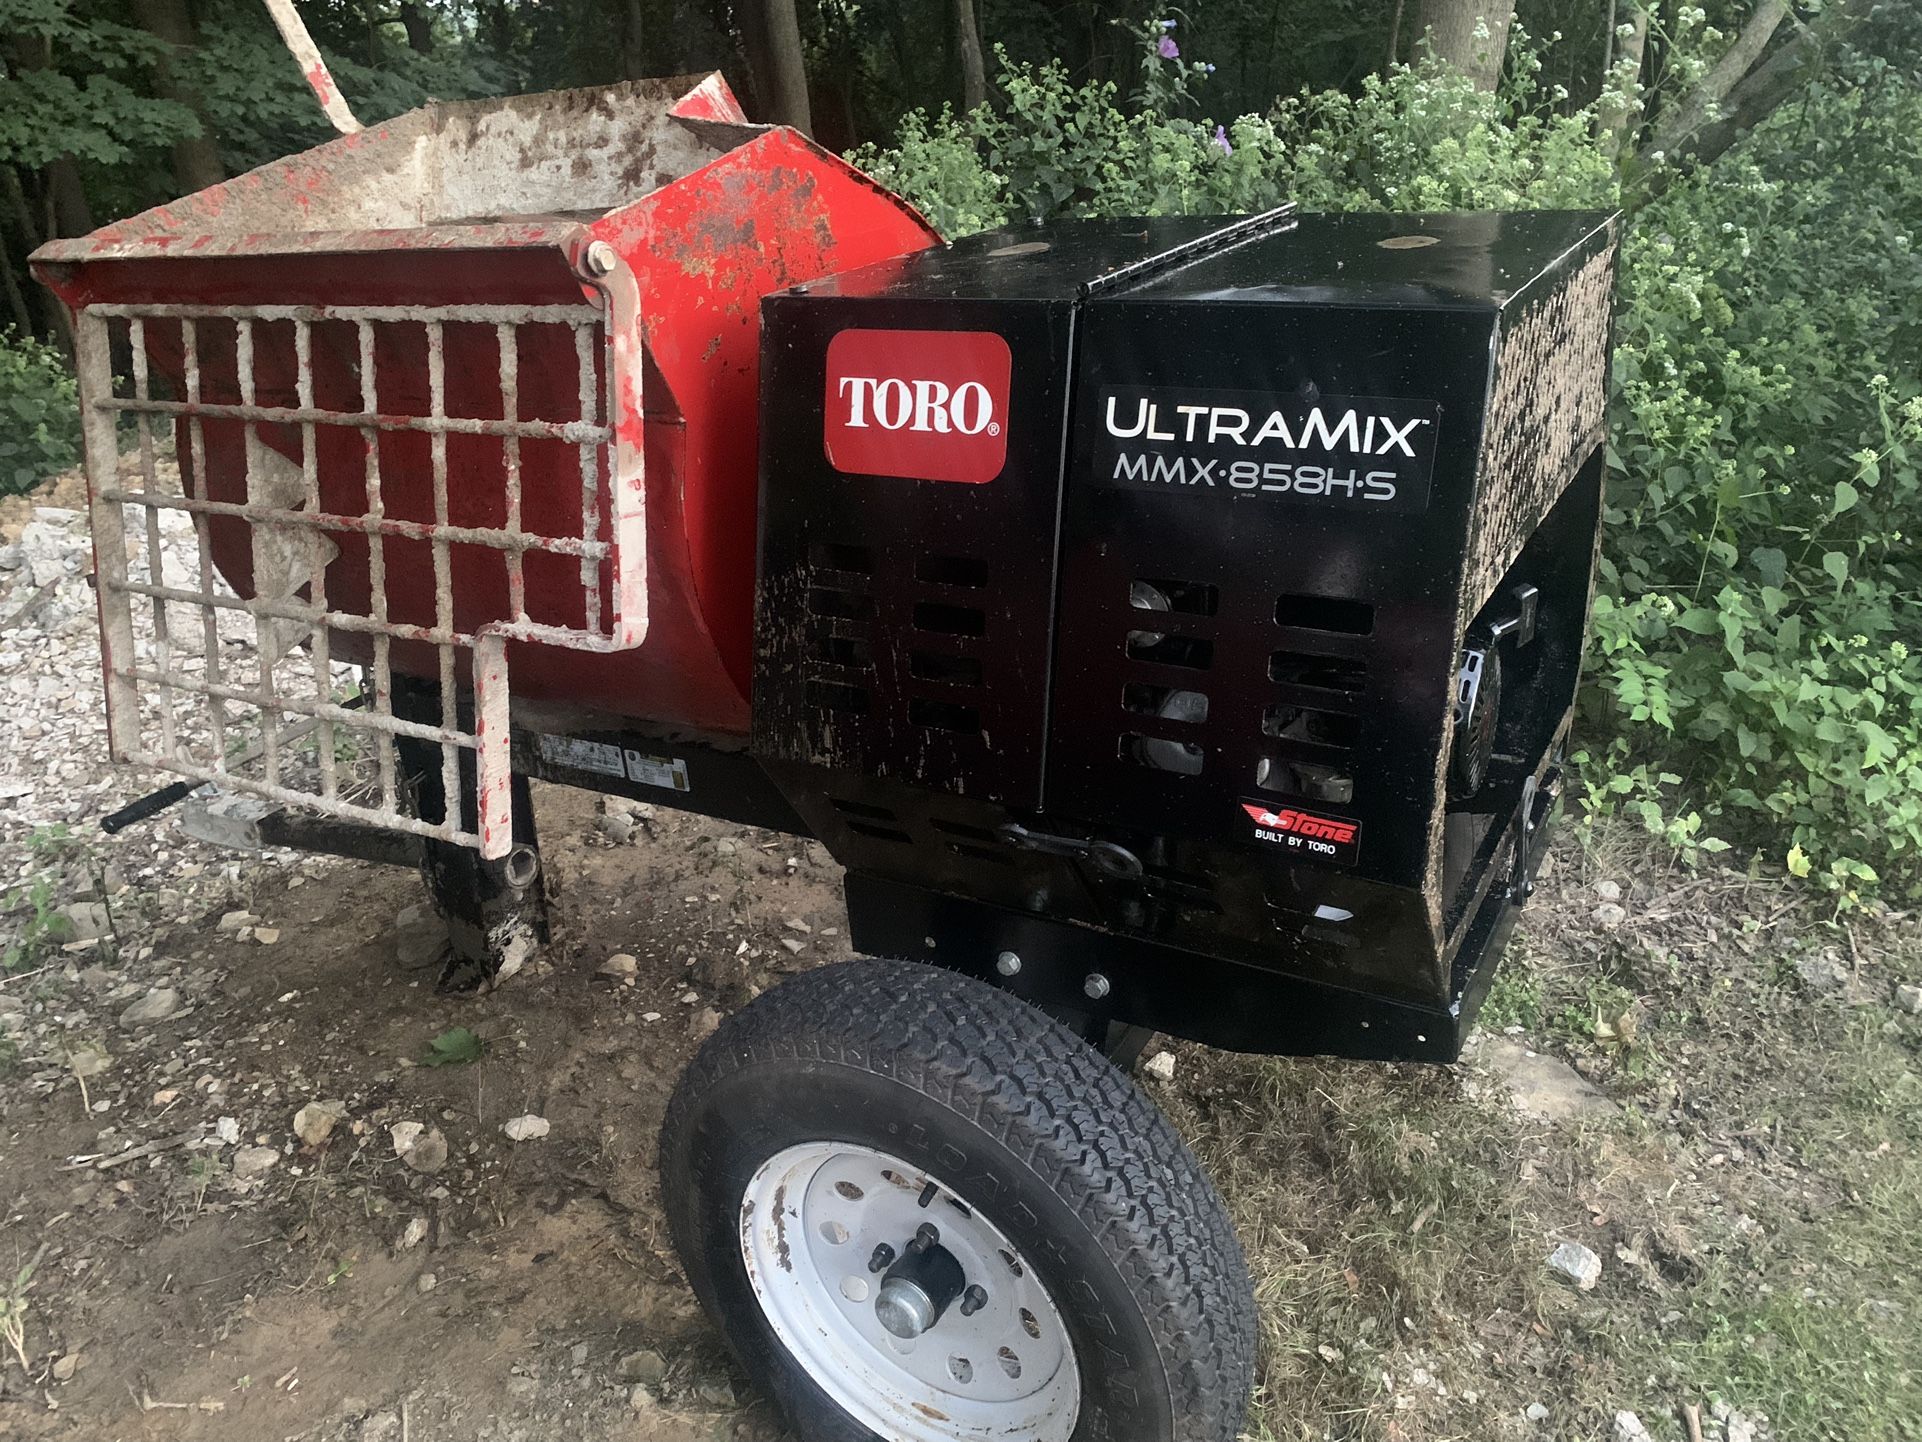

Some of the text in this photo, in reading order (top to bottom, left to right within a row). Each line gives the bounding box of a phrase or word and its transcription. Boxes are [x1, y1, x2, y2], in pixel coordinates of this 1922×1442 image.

[1254, 828, 1336, 855] BUILT BY TORO
